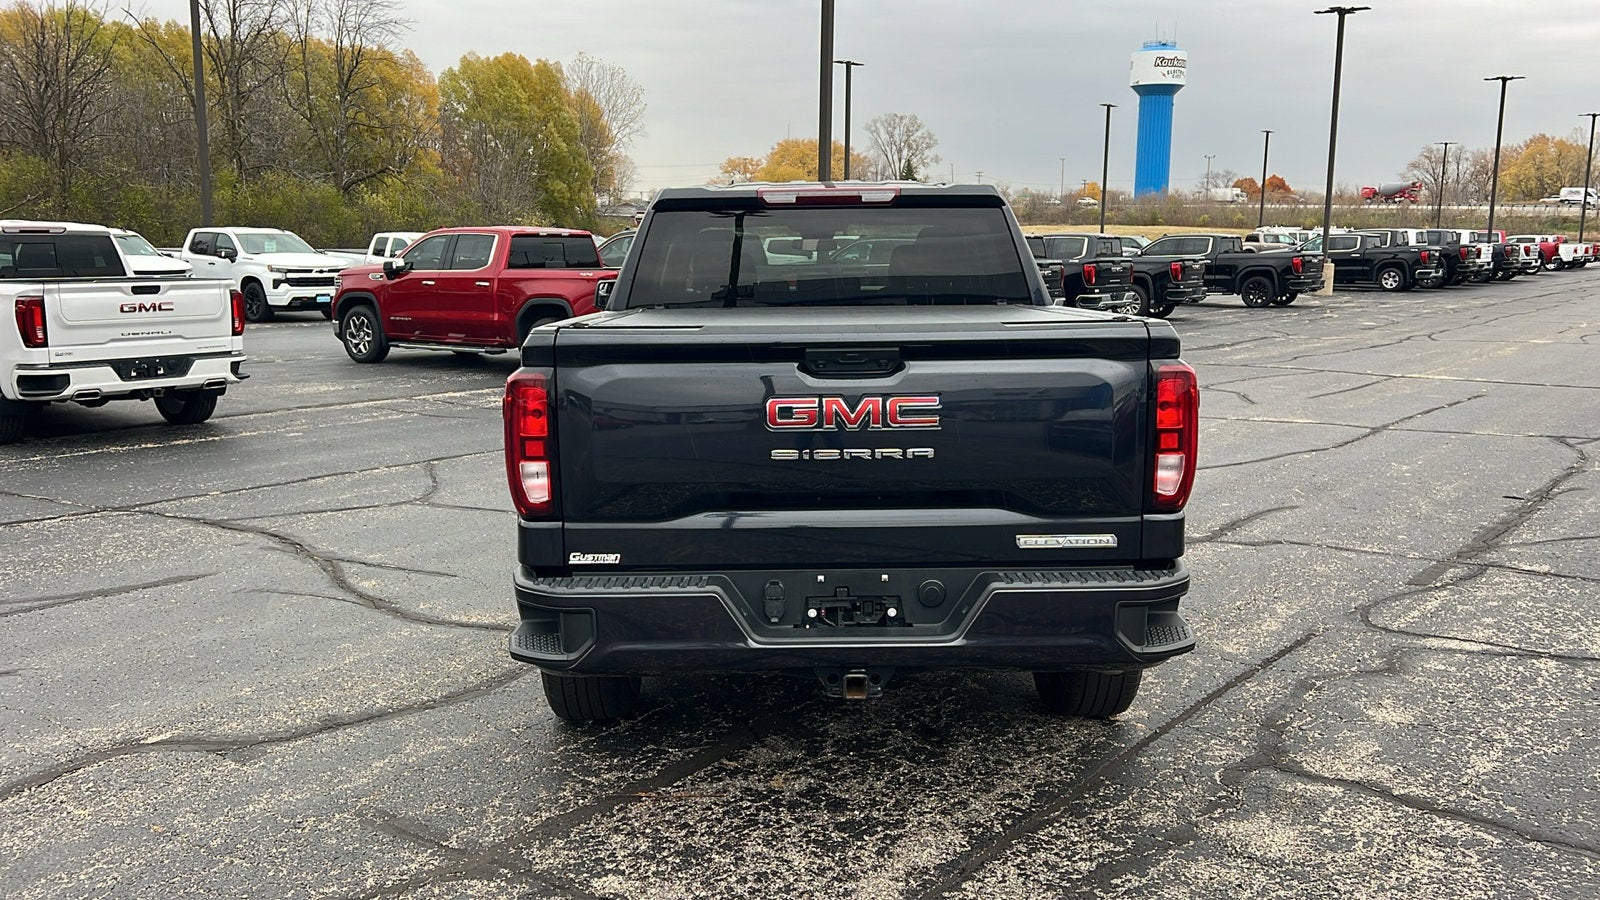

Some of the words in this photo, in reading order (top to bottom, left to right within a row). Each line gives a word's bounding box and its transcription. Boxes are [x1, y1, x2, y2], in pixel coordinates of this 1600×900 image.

[119, 301, 174, 313] GMC
[765, 394, 942, 431] GMC
[770, 448, 935, 460] SIERRA
[1021, 537, 1112, 547] ELEVATION
